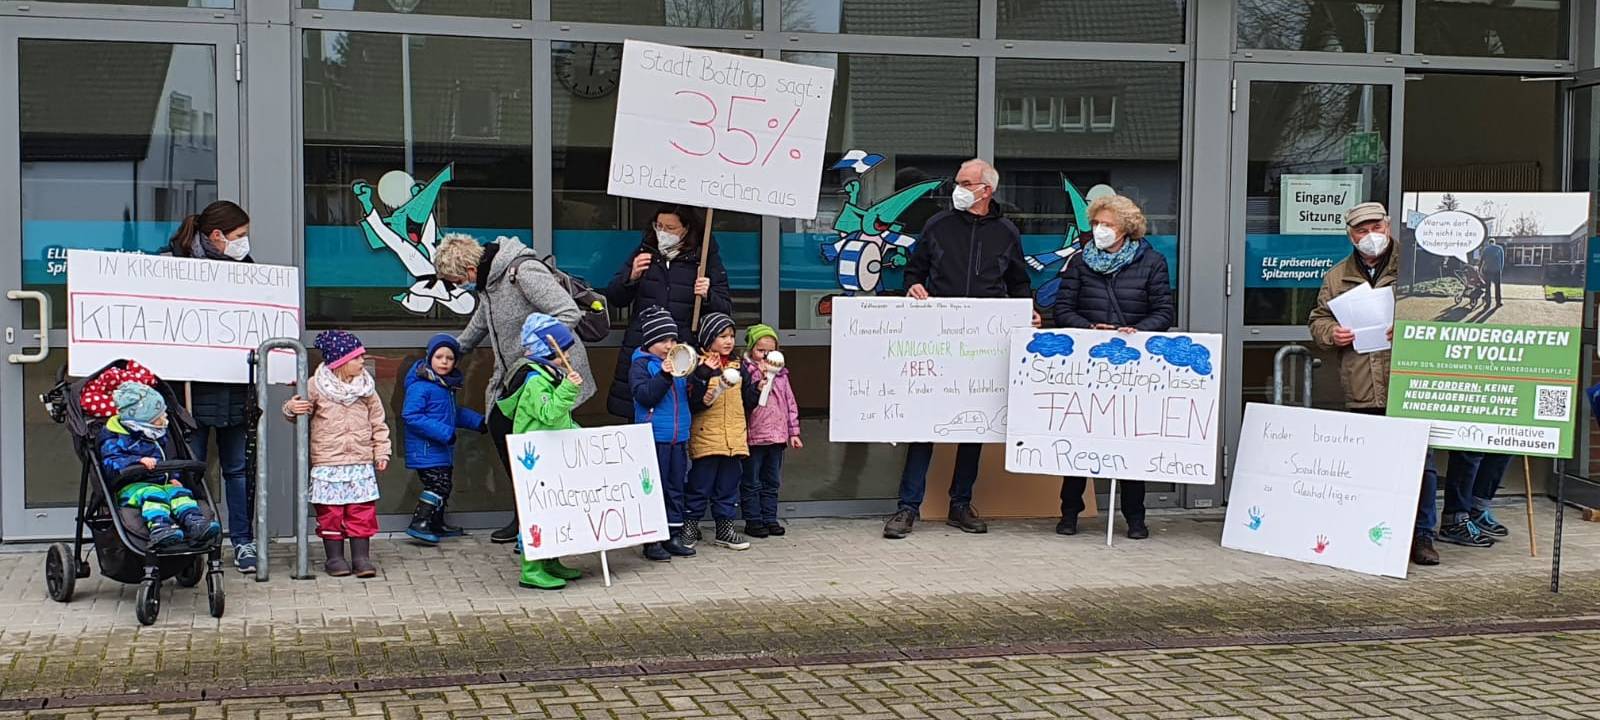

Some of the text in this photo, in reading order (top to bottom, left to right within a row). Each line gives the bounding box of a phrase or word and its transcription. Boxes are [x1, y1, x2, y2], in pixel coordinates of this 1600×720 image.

[640, 49, 692, 80] Stadt
[700, 56, 766, 96] Bottrop
[670, 90, 801, 167] 35%
[700, 174, 761, 202] reichen
[768, 190, 797, 207] aus
[1295, 190, 1347, 206] Eingang/
[1299, 210, 1342, 225] Sitzung
[98, 255, 293, 288] IN KIRCHHELLEN HERRSCHT
[1262, 256, 1333, 269] ELE präsentiert:
[1261, 268, 1319, 281] Spitzensport
[81, 302, 299, 345] KITA-NOTSTAND
[1403, 325, 1570, 346] DER KINDERGARTEN
[1445, 344, 1525, 362] IST VOLL!
[900, 359, 943, 377] ABER:
[1030, 359, 1085, 386] Stadt
[1095, 361, 1161, 393] Bottrop
[878, 382, 896, 396] die
[907, 378, 933, 396] Kinder
[1409, 379, 1516, 393] WIR FORDERN: KEINE
[1404, 390, 1519, 405] NEUBAUGEBIETE OHNE
[1033, 391, 1215, 440] FAMILIEN
[1402, 401, 1519, 417] KINDERGARTENPLÄTZE
[1263, 422, 1365, 446] Kinder brauchen
[1487, 435, 1556, 450] Feldhausen
[1497, 426, 1545, 438] Initiative
[562, 431, 635, 469] UNSER
[1015, 439, 1209, 477] im Regen stehen
[526, 474, 635, 513] Kindergarten
[587, 503, 658, 543] VOLL
